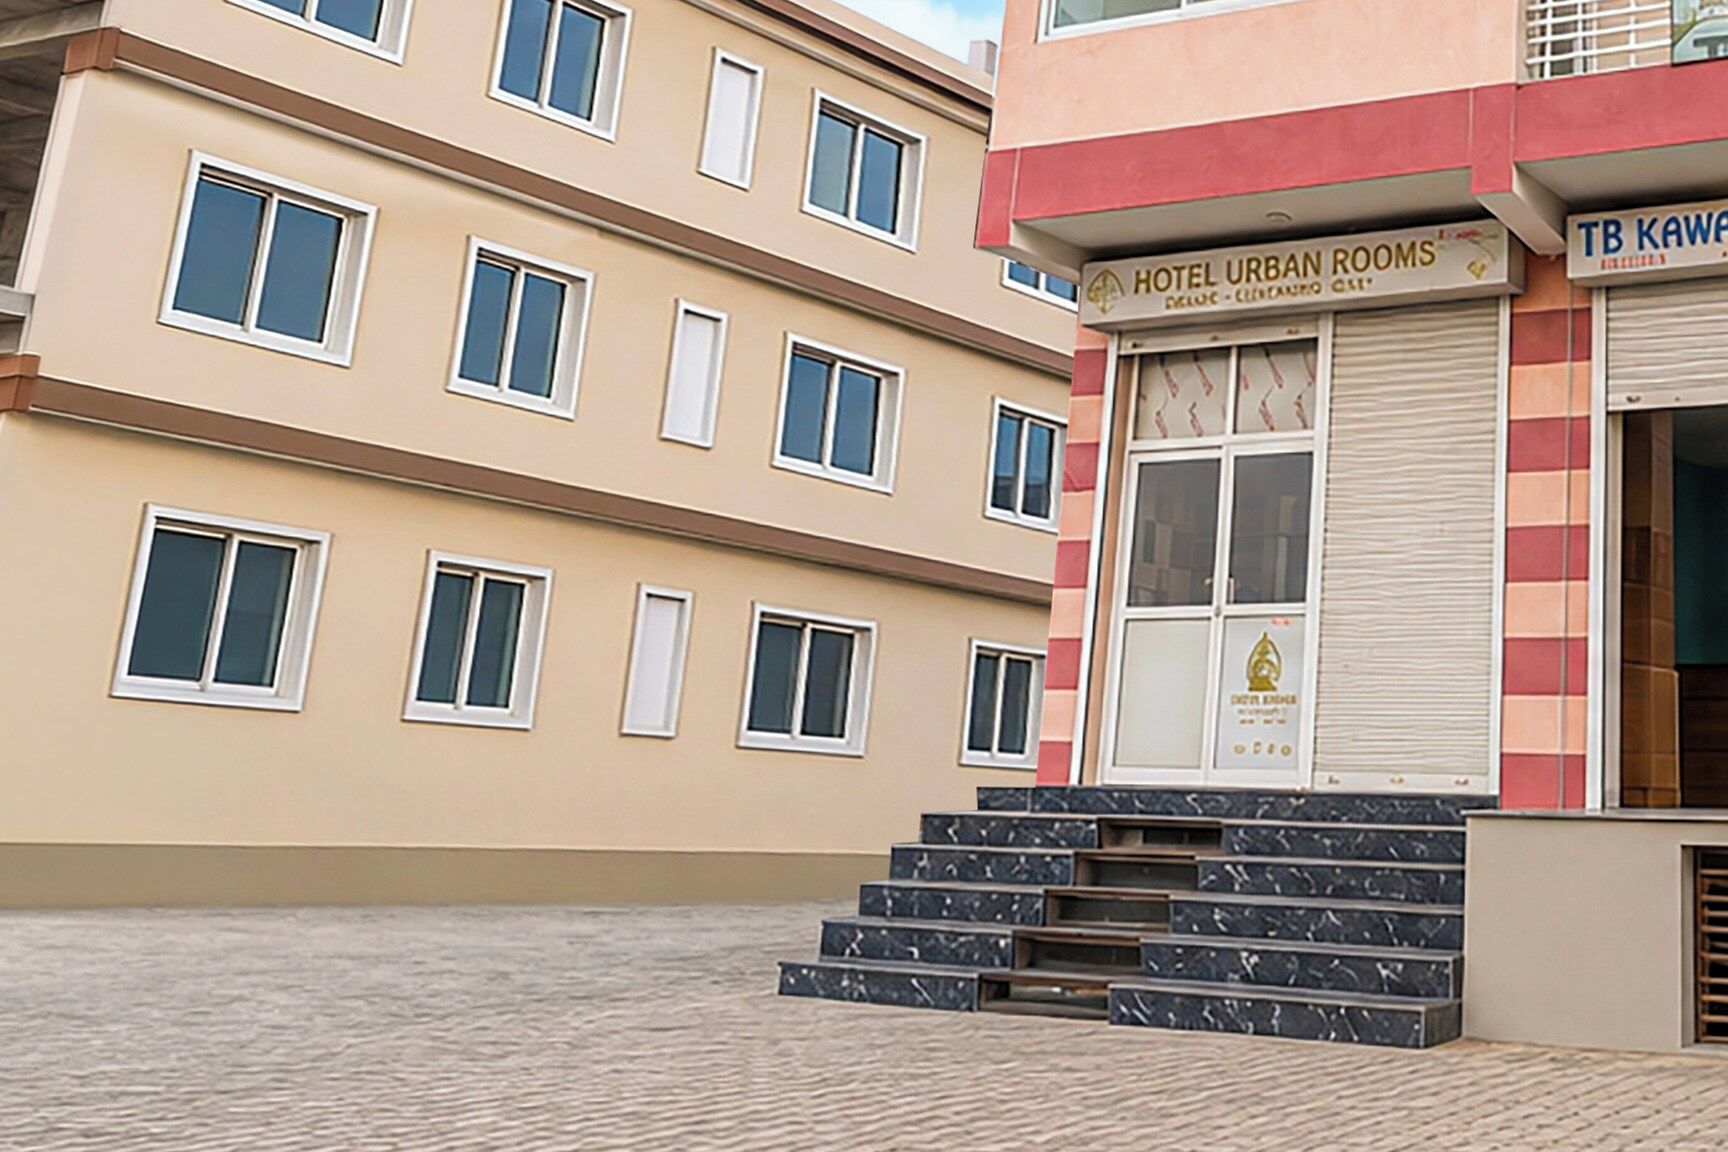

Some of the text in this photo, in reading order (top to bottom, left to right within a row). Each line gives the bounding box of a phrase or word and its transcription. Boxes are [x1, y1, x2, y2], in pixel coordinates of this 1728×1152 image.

[1577, 219, 1624, 257] TB
[1133, 263, 1217, 295] HOTEL
[1226, 251, 1322, 285] URBAN
[1332, 240, 1436, 274] ROOMS
